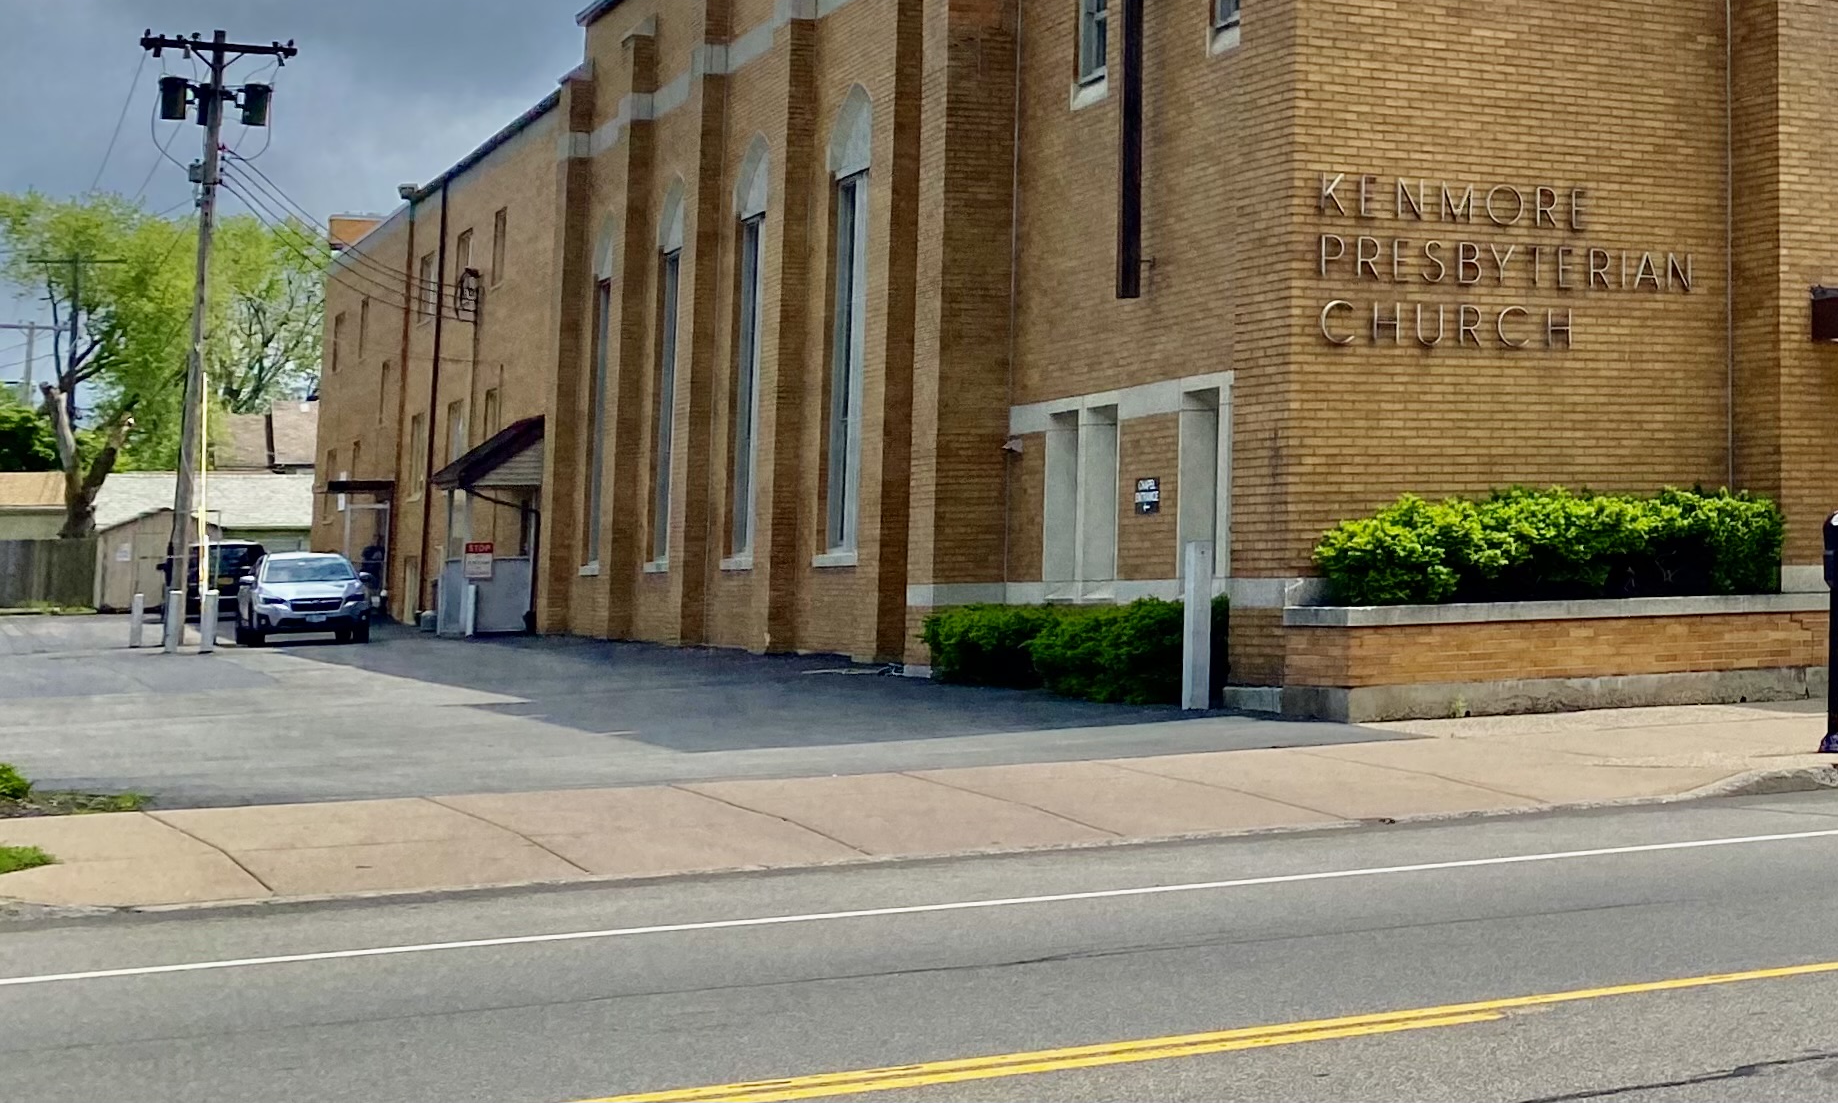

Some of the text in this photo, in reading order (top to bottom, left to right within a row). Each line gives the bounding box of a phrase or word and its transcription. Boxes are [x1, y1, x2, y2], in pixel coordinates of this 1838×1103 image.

[1320, 171, 1589, 231] KENMORE
[1320, 234, 1693, 292] PRESBYTERIAN
[1320, 299, 1573, 347] CHURCH
[468, 544, 491, 552] STOP
